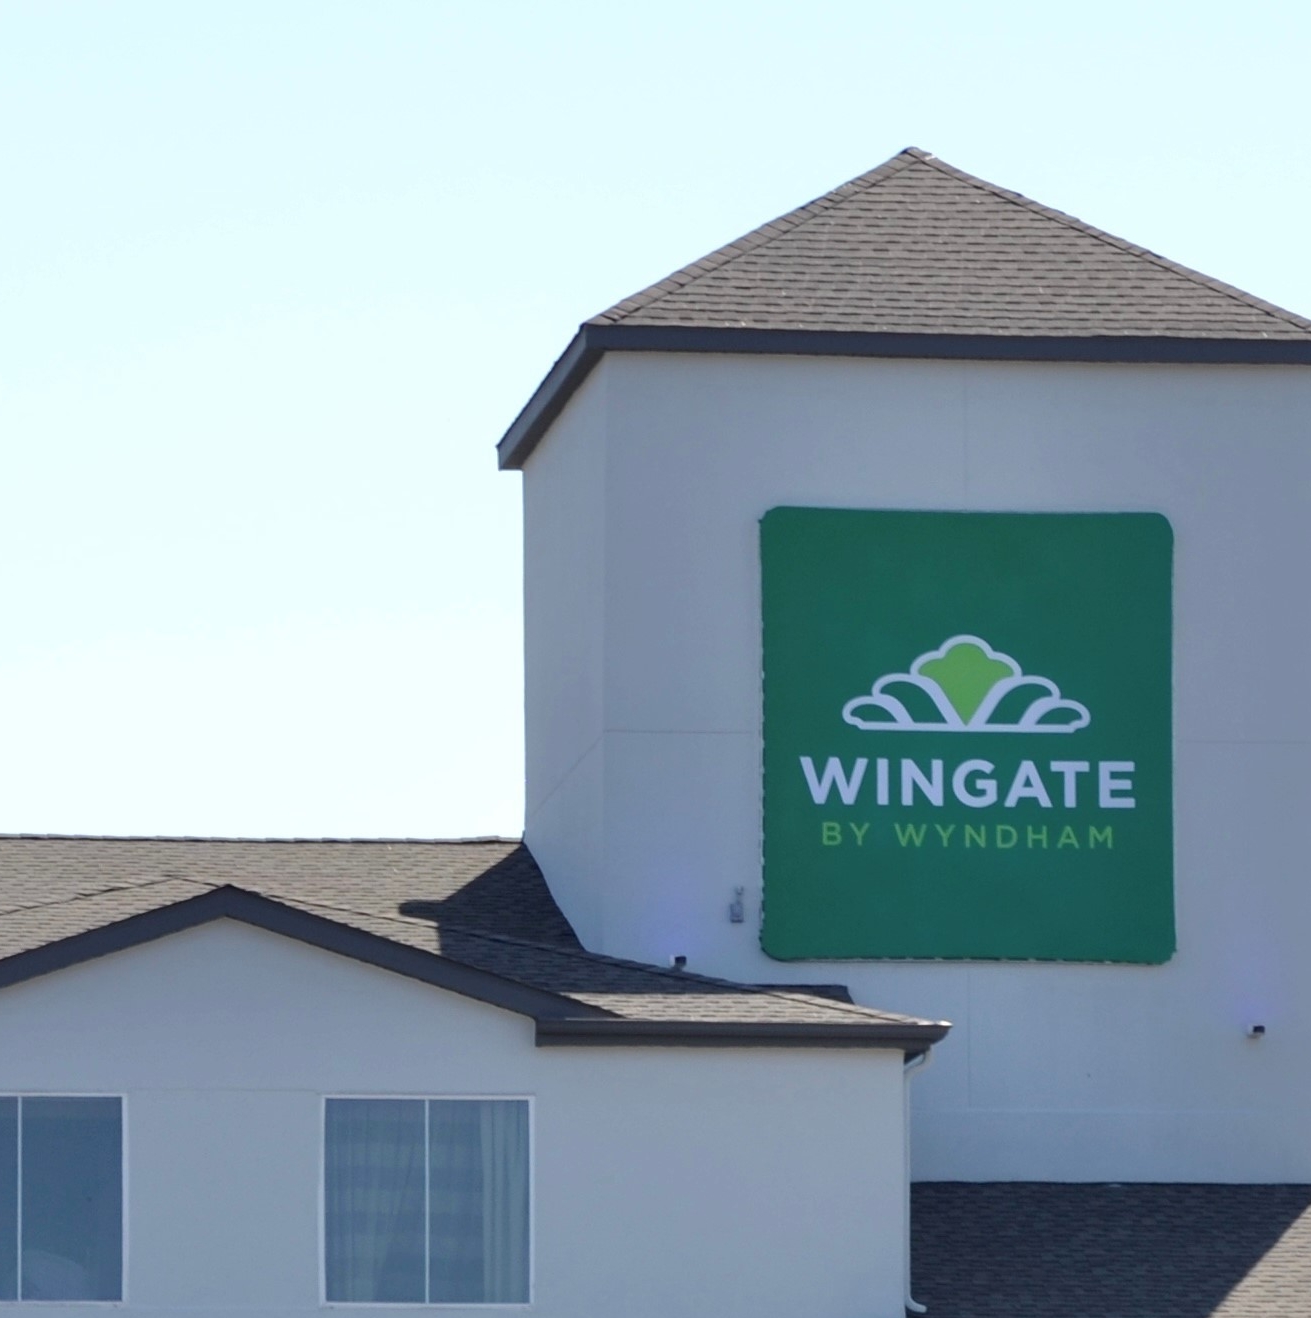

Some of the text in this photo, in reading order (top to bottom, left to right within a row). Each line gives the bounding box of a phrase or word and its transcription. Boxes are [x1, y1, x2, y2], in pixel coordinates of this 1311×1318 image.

[799, 756, 1136, 808] WINGATE
[822, 822, 1114, 849] BY WYNDHAM
